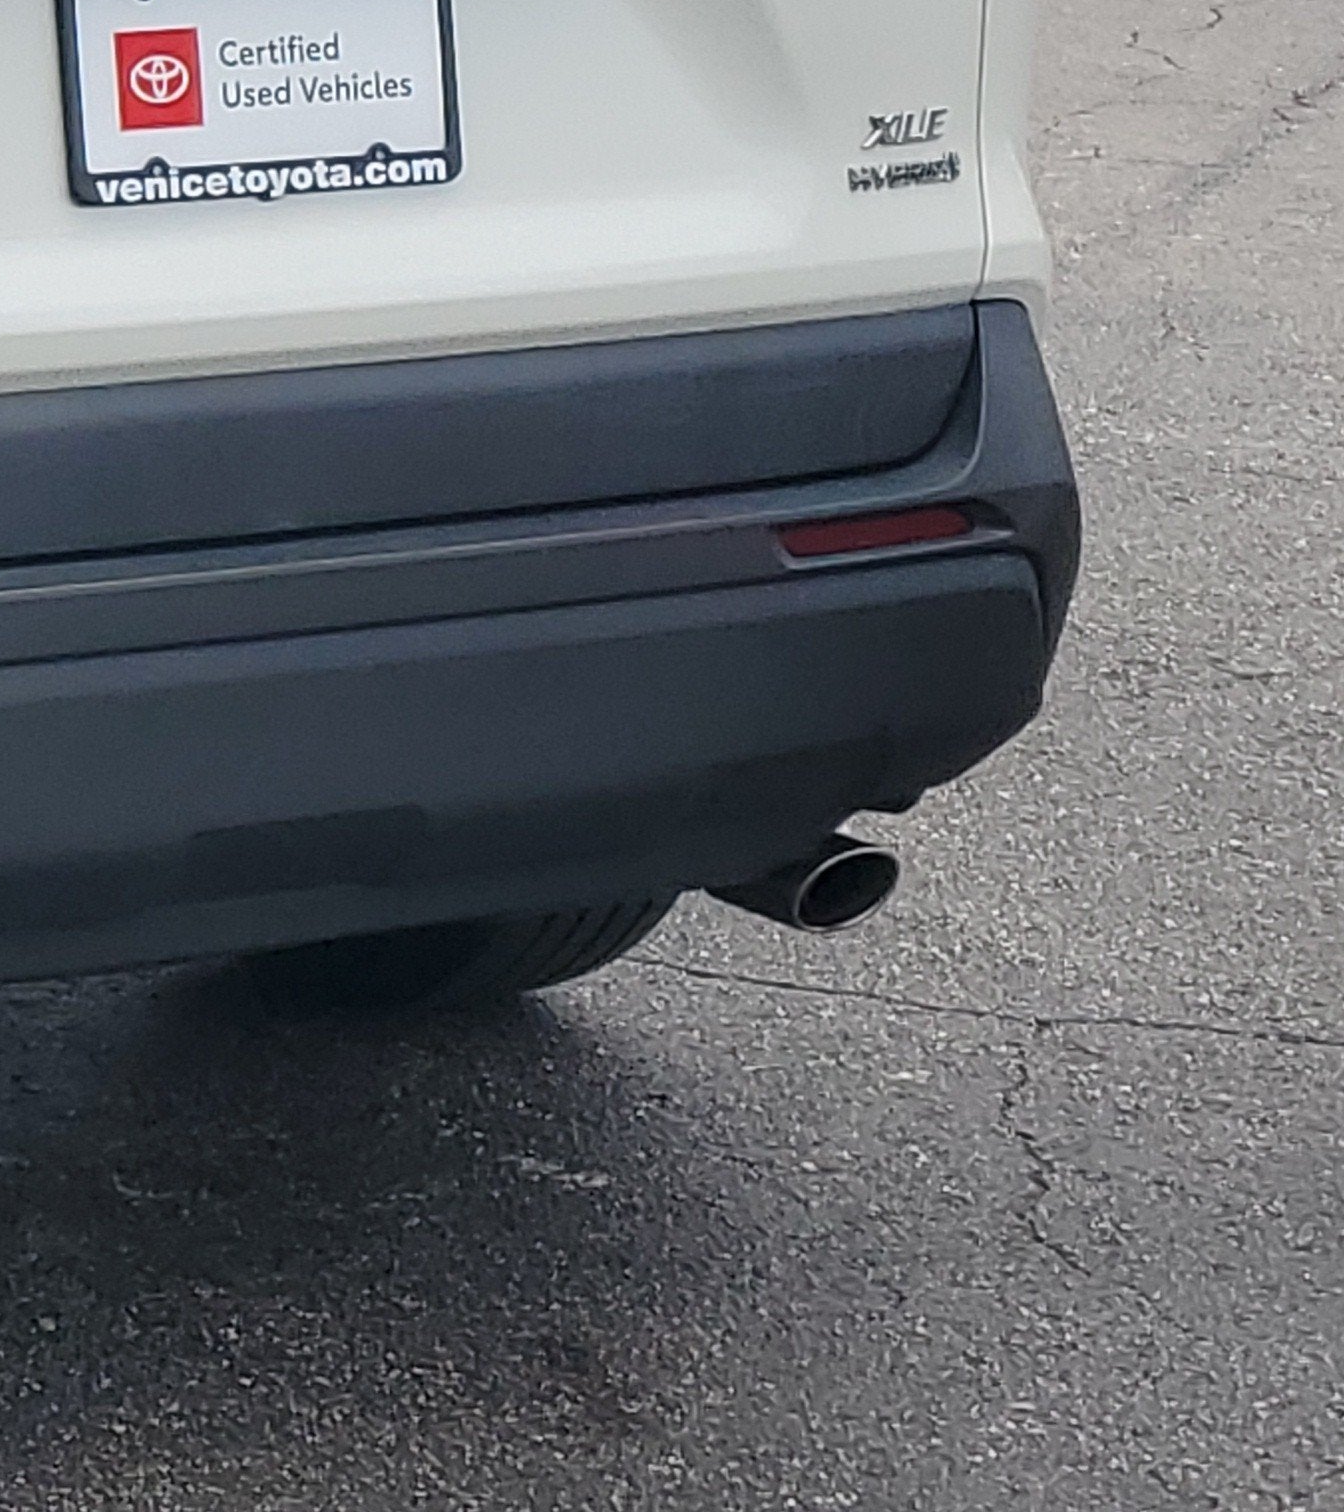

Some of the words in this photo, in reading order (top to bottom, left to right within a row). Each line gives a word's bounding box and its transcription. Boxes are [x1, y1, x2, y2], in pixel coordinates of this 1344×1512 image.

[218, 32, 340, 67] Certified
[221, 73, 291, 108] Used
[298, 71, 414, 105] Vehicles
[95, 153, 447, 204] venicetoyota.com
